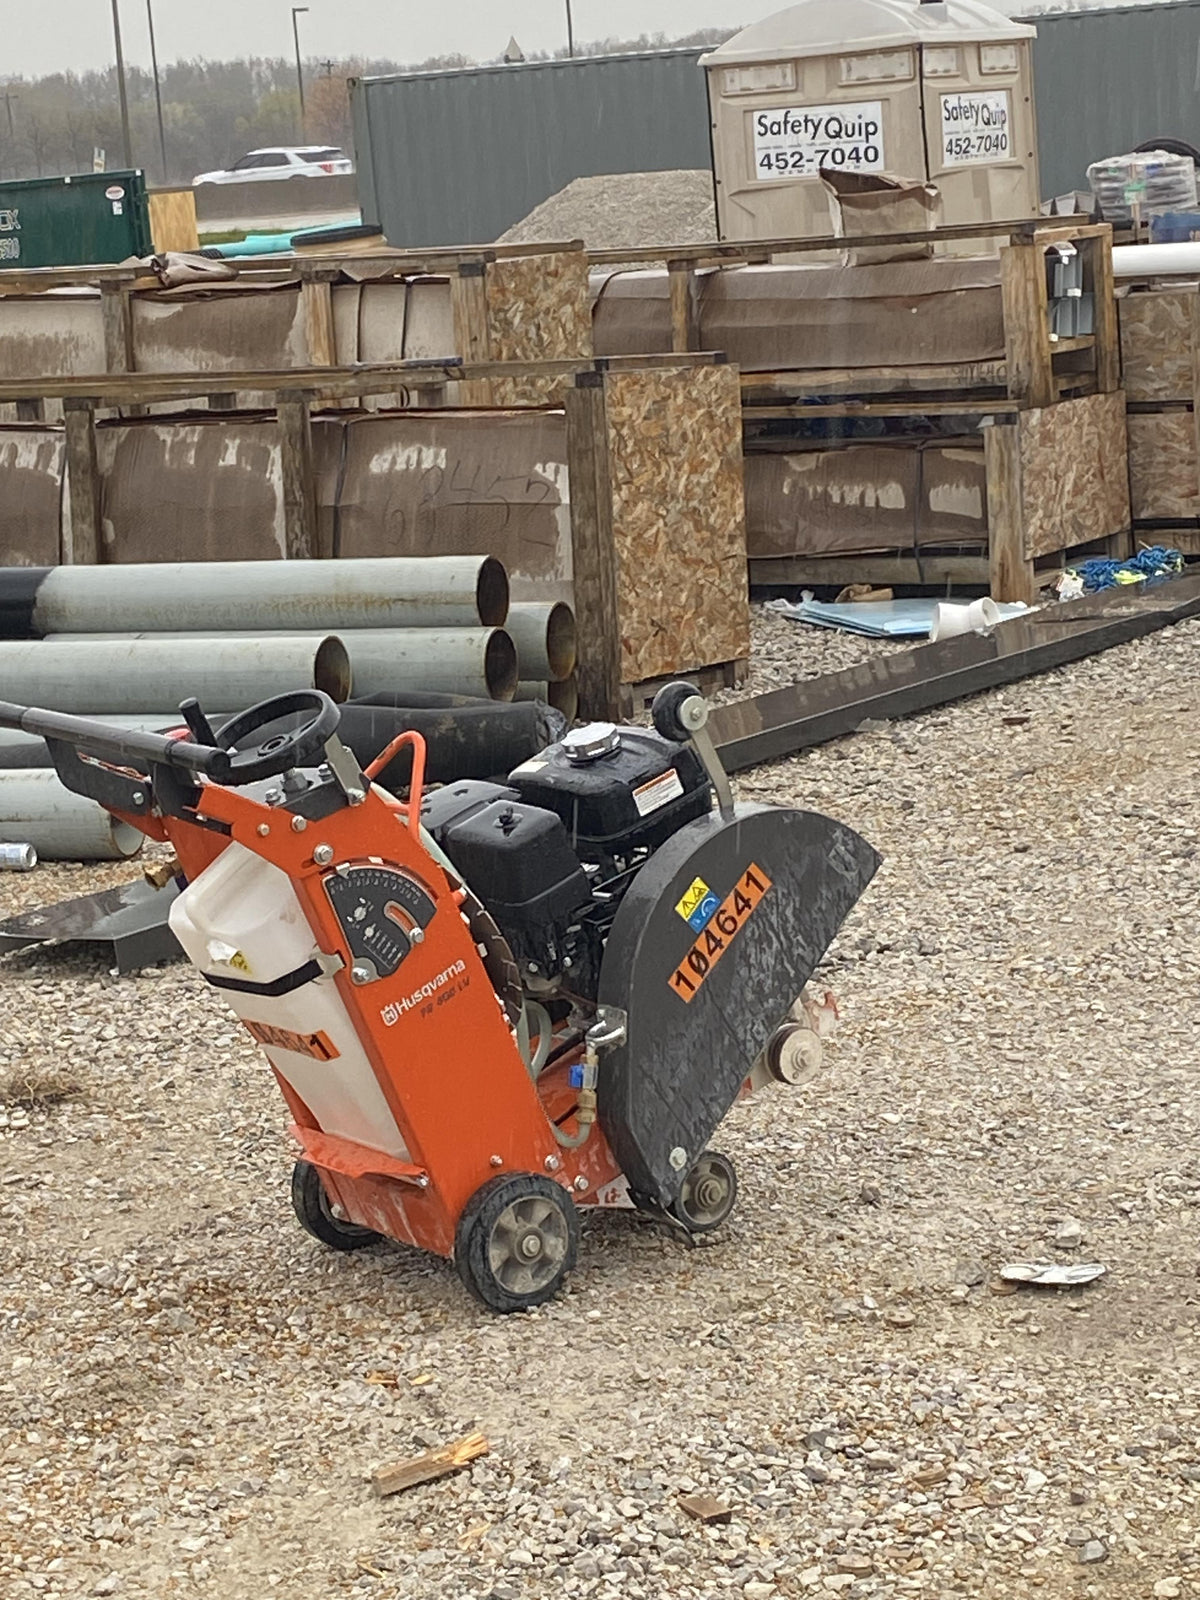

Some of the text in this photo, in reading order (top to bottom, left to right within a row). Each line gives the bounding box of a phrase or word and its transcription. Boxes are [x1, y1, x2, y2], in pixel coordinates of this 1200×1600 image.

[757, 110, 878, 143] Safety Quip
[943, 96, 1007, 130] Safety Quip
[760, 145, 879, 170] 452-7040
[945, 133, 1007, 155] 452-7040
[675, 870, 765, 991] 104641
[395, 959, 466, 1015] Husqvarna
